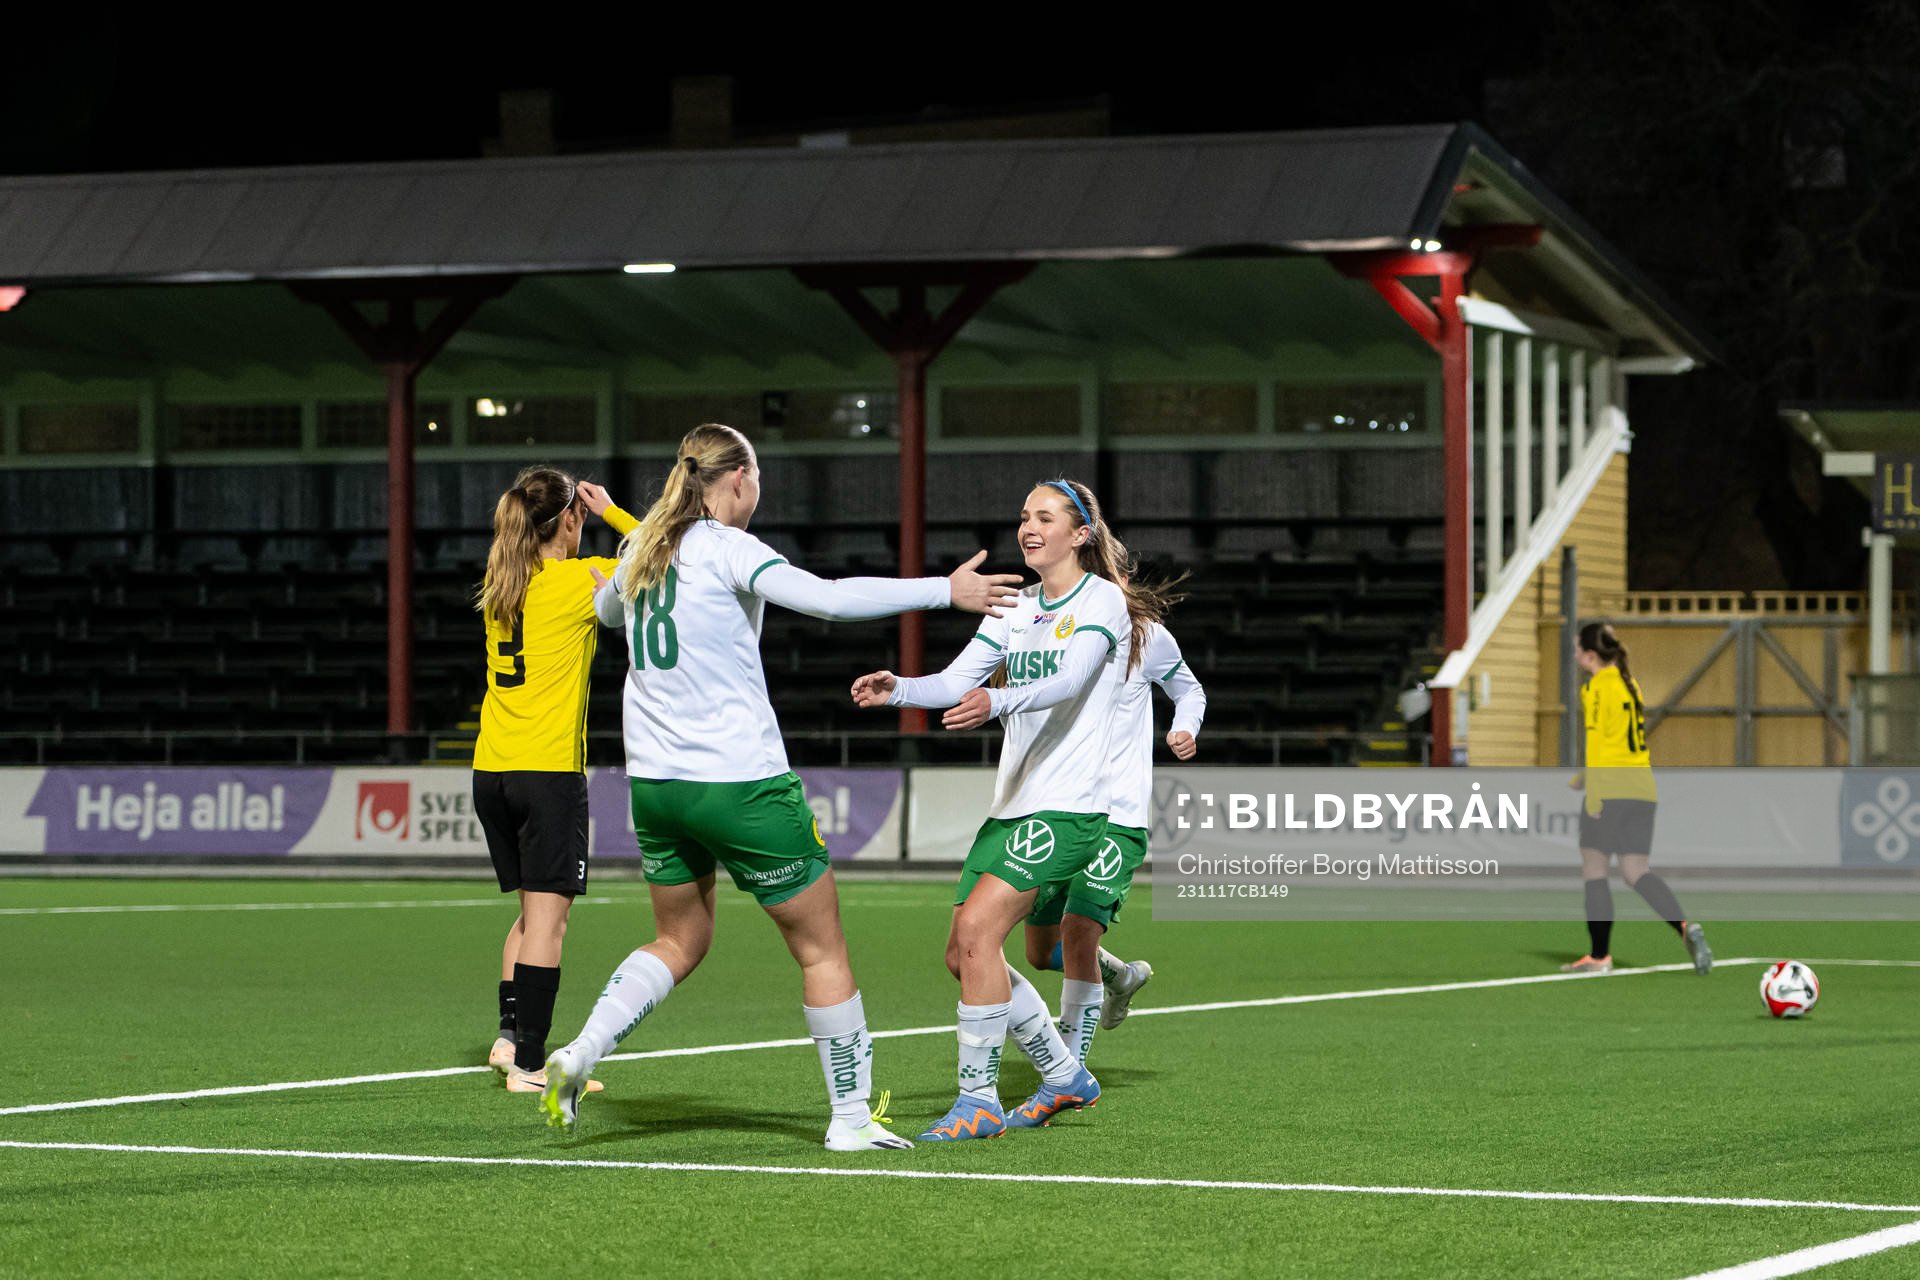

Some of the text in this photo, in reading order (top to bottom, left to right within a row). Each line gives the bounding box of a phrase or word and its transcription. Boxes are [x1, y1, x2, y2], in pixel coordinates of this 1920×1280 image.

[633, 565, 679, 670] 18
[77, 781, 284, 840] Heja alla!
[420, 792, 475, 815] SVE
[419, 820, 480, 841] SPEL
[578, 860, 586, 880] 3
